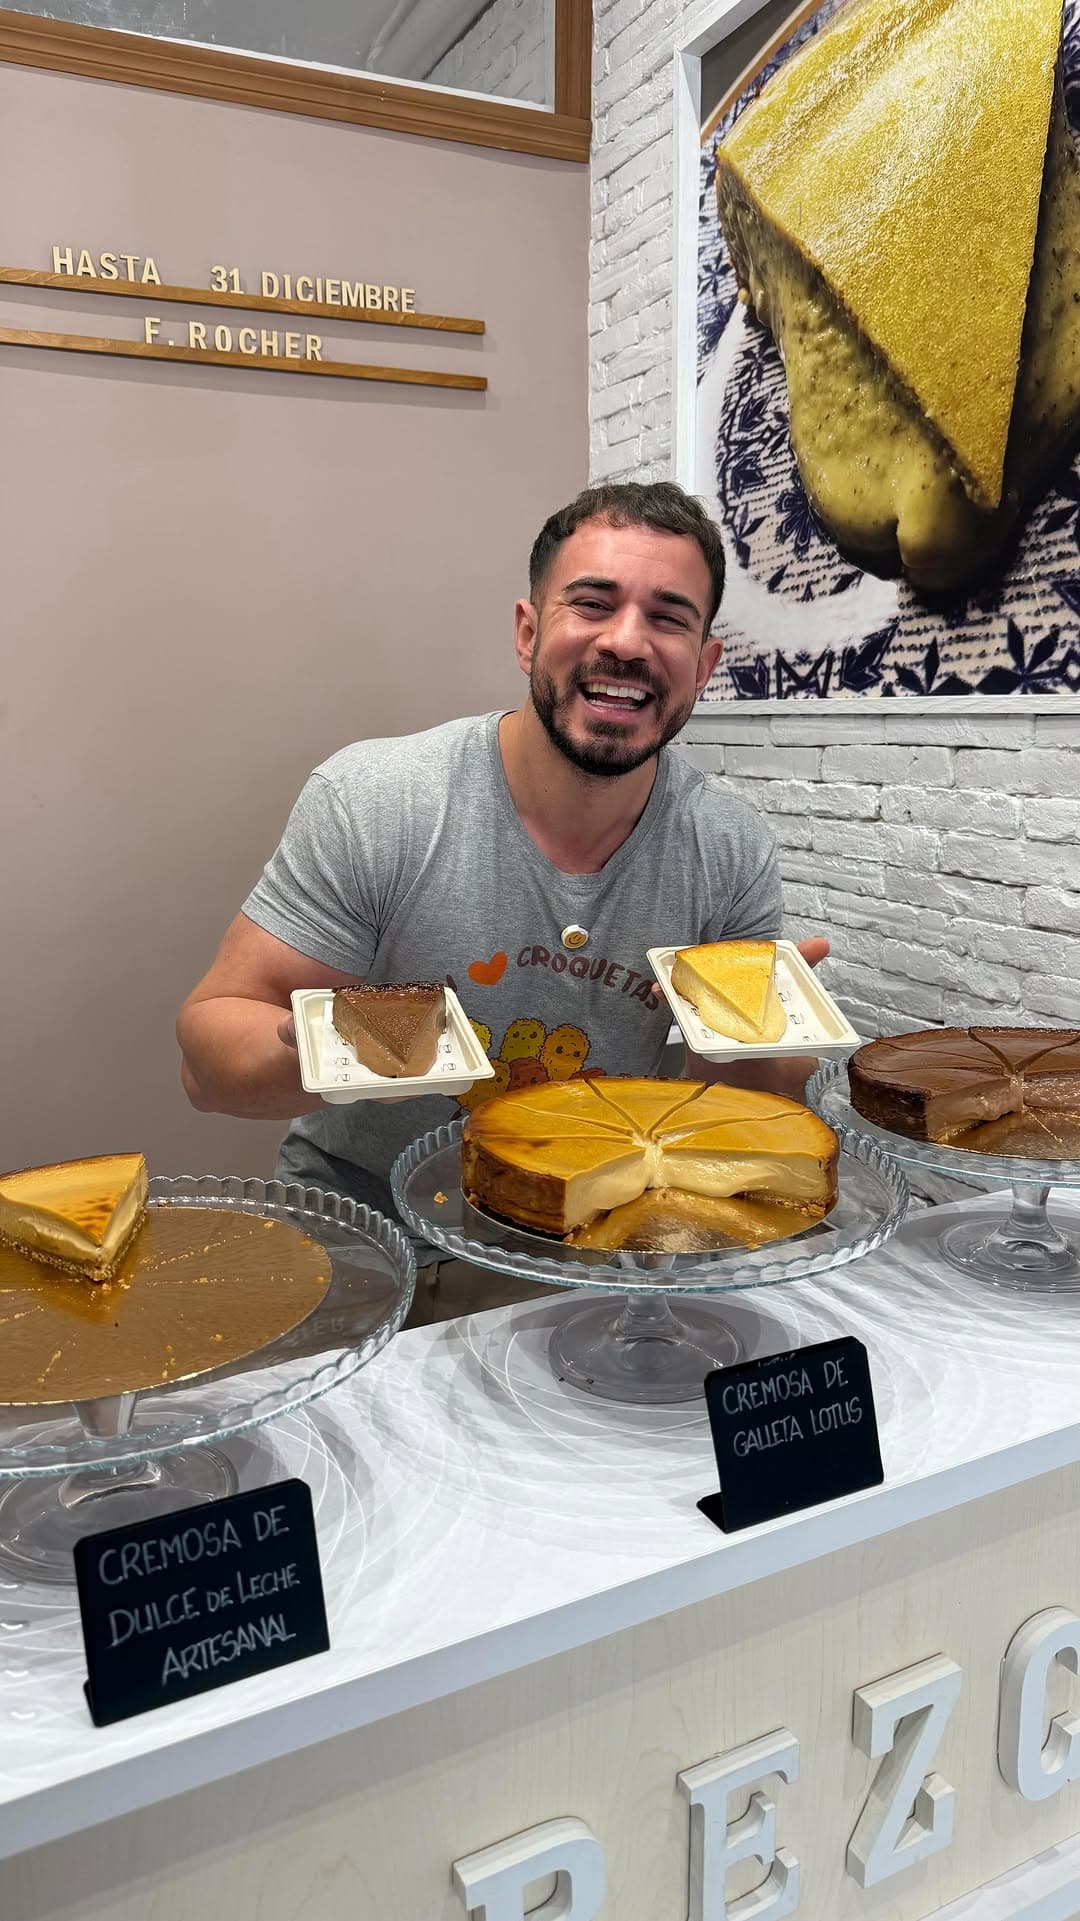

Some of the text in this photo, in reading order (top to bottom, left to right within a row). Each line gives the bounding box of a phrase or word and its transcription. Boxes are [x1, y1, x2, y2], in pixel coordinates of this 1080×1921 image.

[52, 245, 417, 314] HASTA 31 DICIEMBRE
[144, 316, 323, 361] F. ROCHER
[516, 944, 661, 1010] CROQUETAS
[721, 1367, 814, 1415] CREMOSA
[823, 1357, 849, 1390] DE
[733, 1396, 863, 1457] GALLETA LOTUS
[98, 1504, 290, 1586] CREMOSA DE
[107, 1586, 200, 1648] DULCE
[161, 1613, 297, 1687] ARTESANAL
